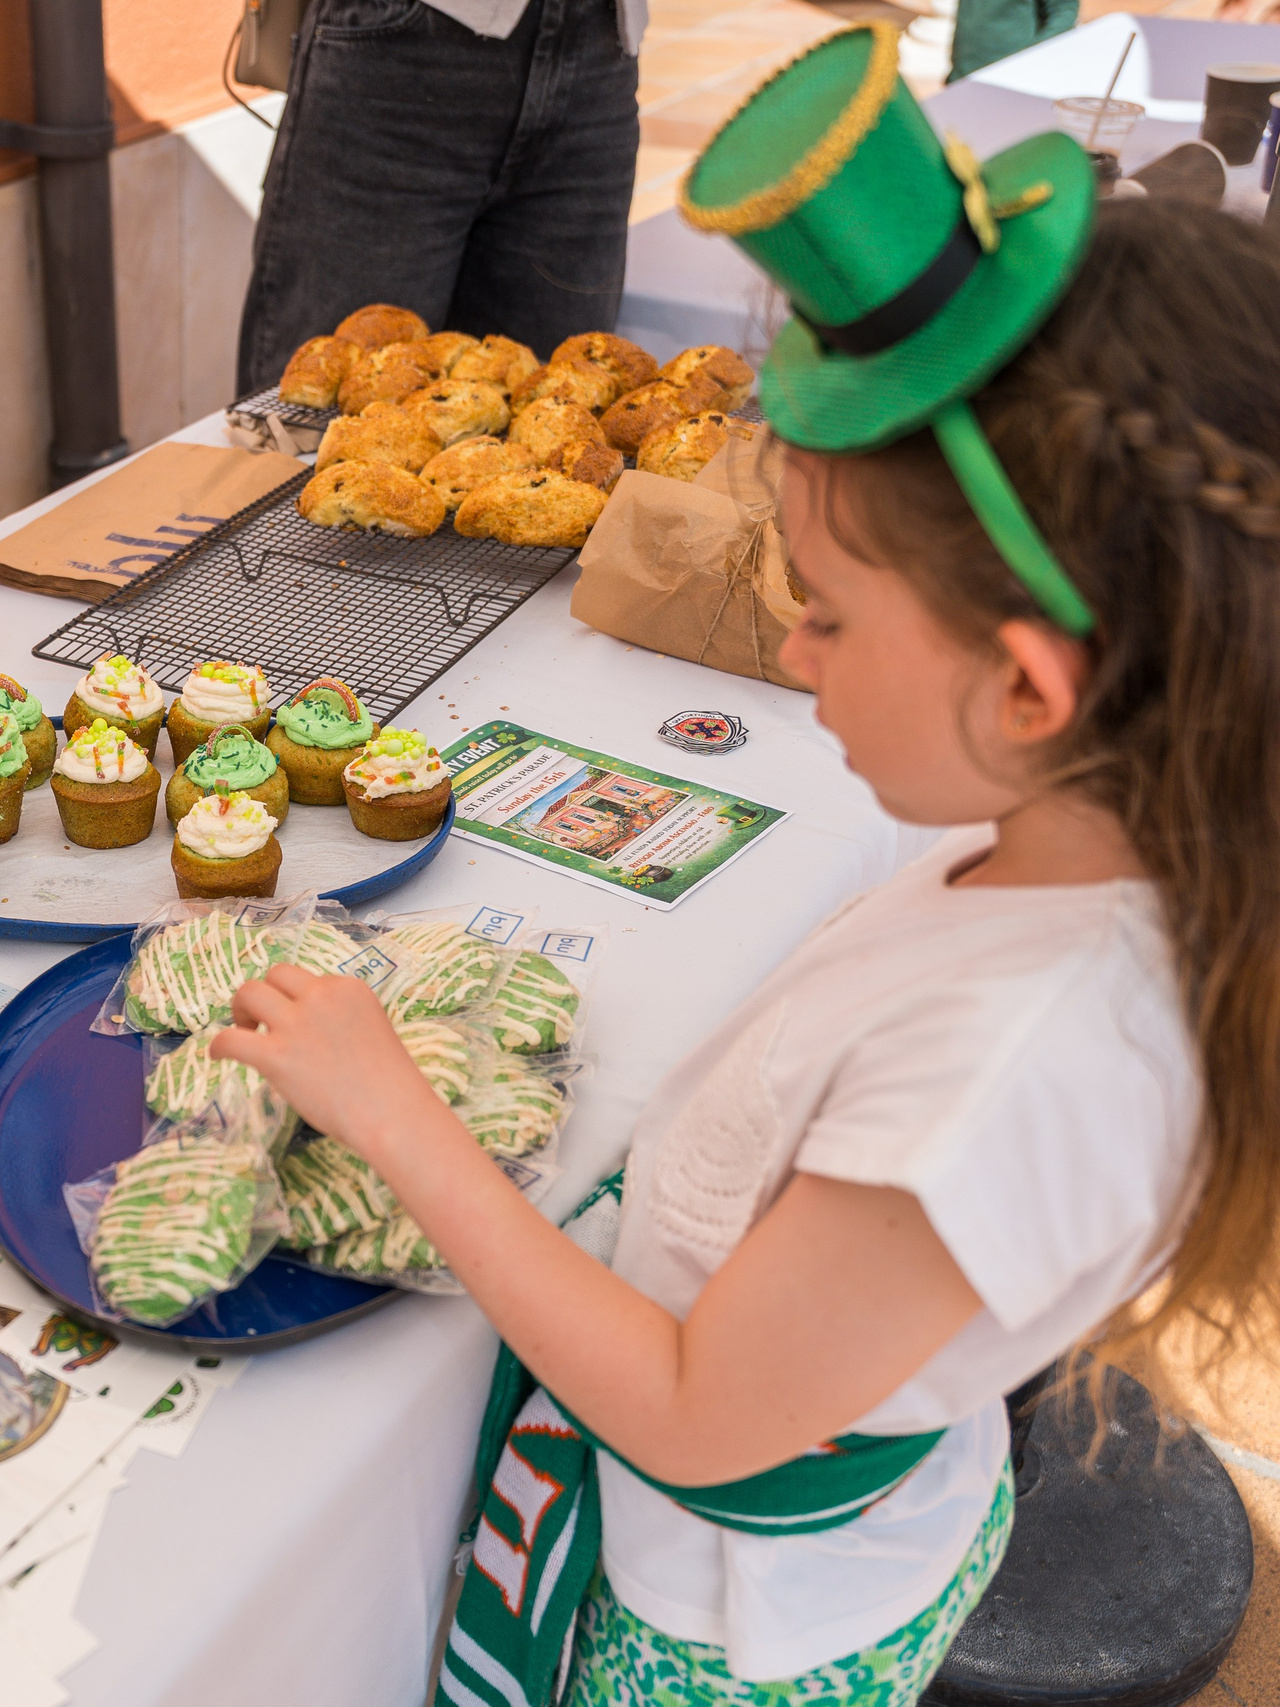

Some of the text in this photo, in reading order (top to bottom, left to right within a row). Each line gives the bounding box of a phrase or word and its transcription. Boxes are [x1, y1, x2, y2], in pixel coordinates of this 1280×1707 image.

[67, 512, 228, 579] blu
[456, 738, 501, 764] EVENT
[464, 754, 552, 813] ST. PATRICK'S PARADE
[497, 770, 566, 813] Sunday the 15th
[631, 843, 649, 856] FUNDS
[646, 831, 665, 844] RAISED
[663, 820, 679, 833] TODAY
[677, 806, 697, 821] SUPPORT
[251, 911, 274, 924] blu
[481, 916, 508, 936] blu
[556, 937, 578, 953] blu
[354, 958, 385, 979] blu
